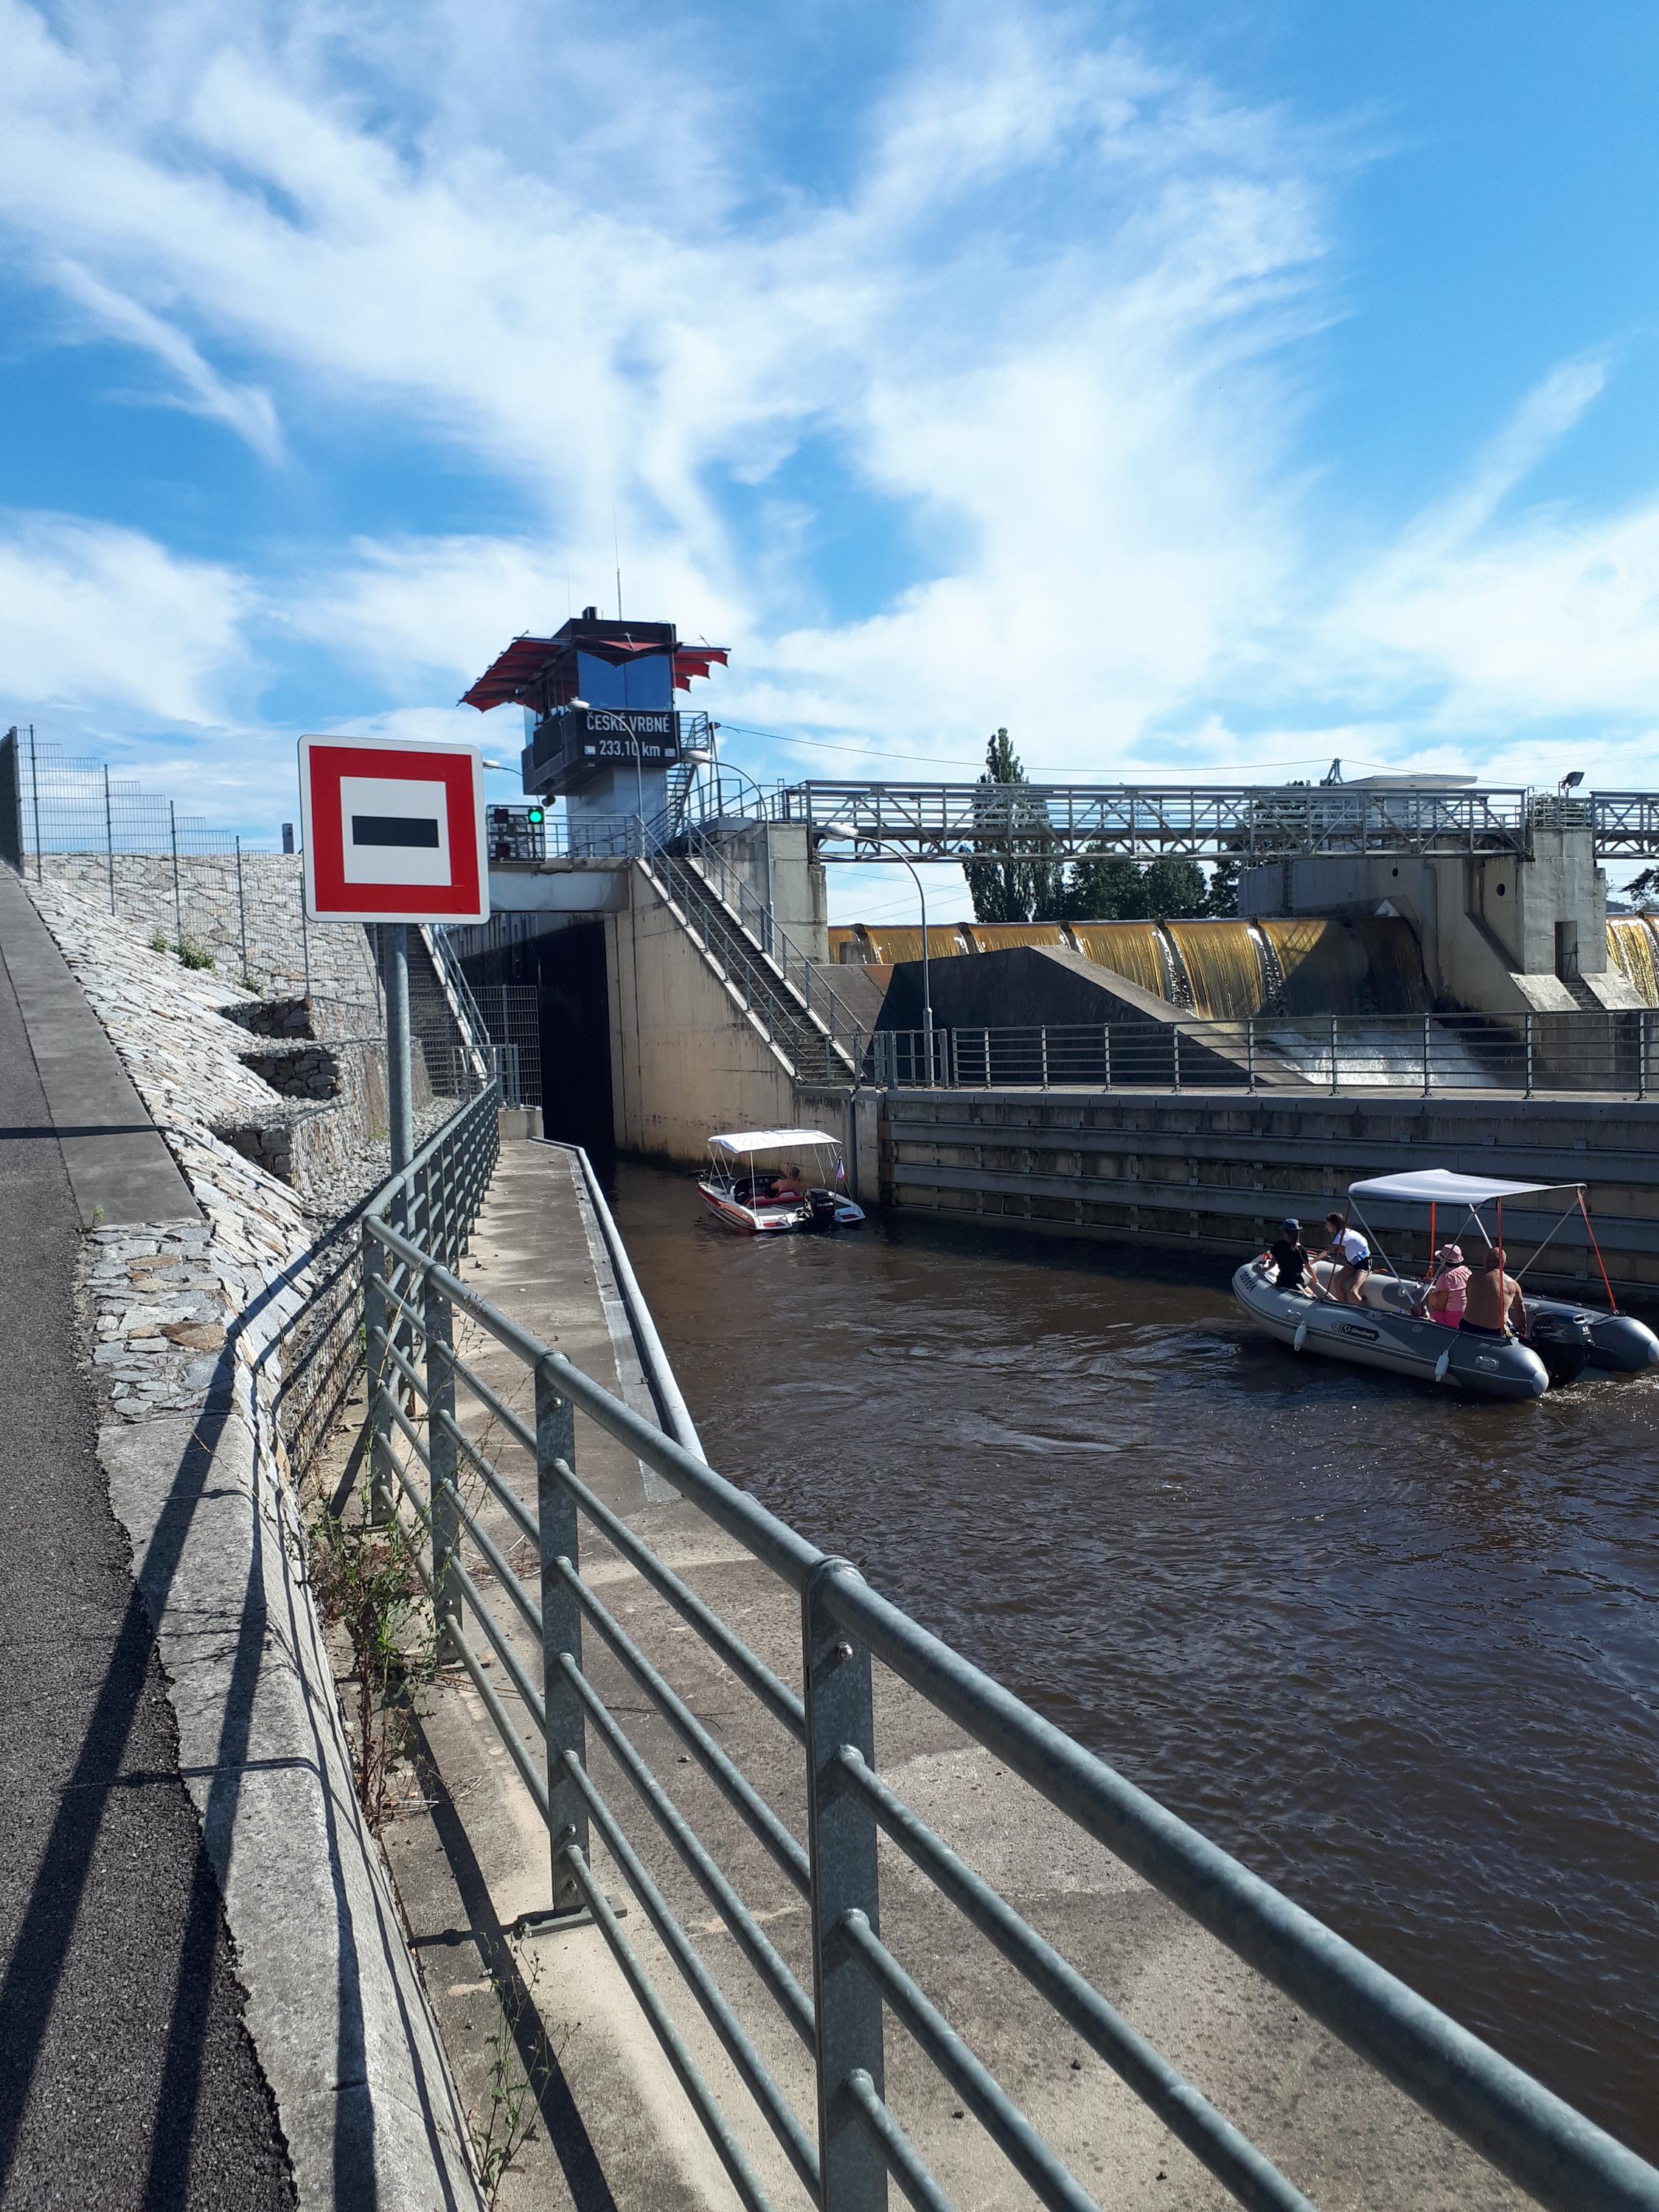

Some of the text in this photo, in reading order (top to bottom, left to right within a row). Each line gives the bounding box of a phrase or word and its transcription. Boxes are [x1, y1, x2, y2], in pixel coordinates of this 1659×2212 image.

[586, 712, 670, 733] ČESKÉ VRBNÉ
[642, 741, 661, 757] km
